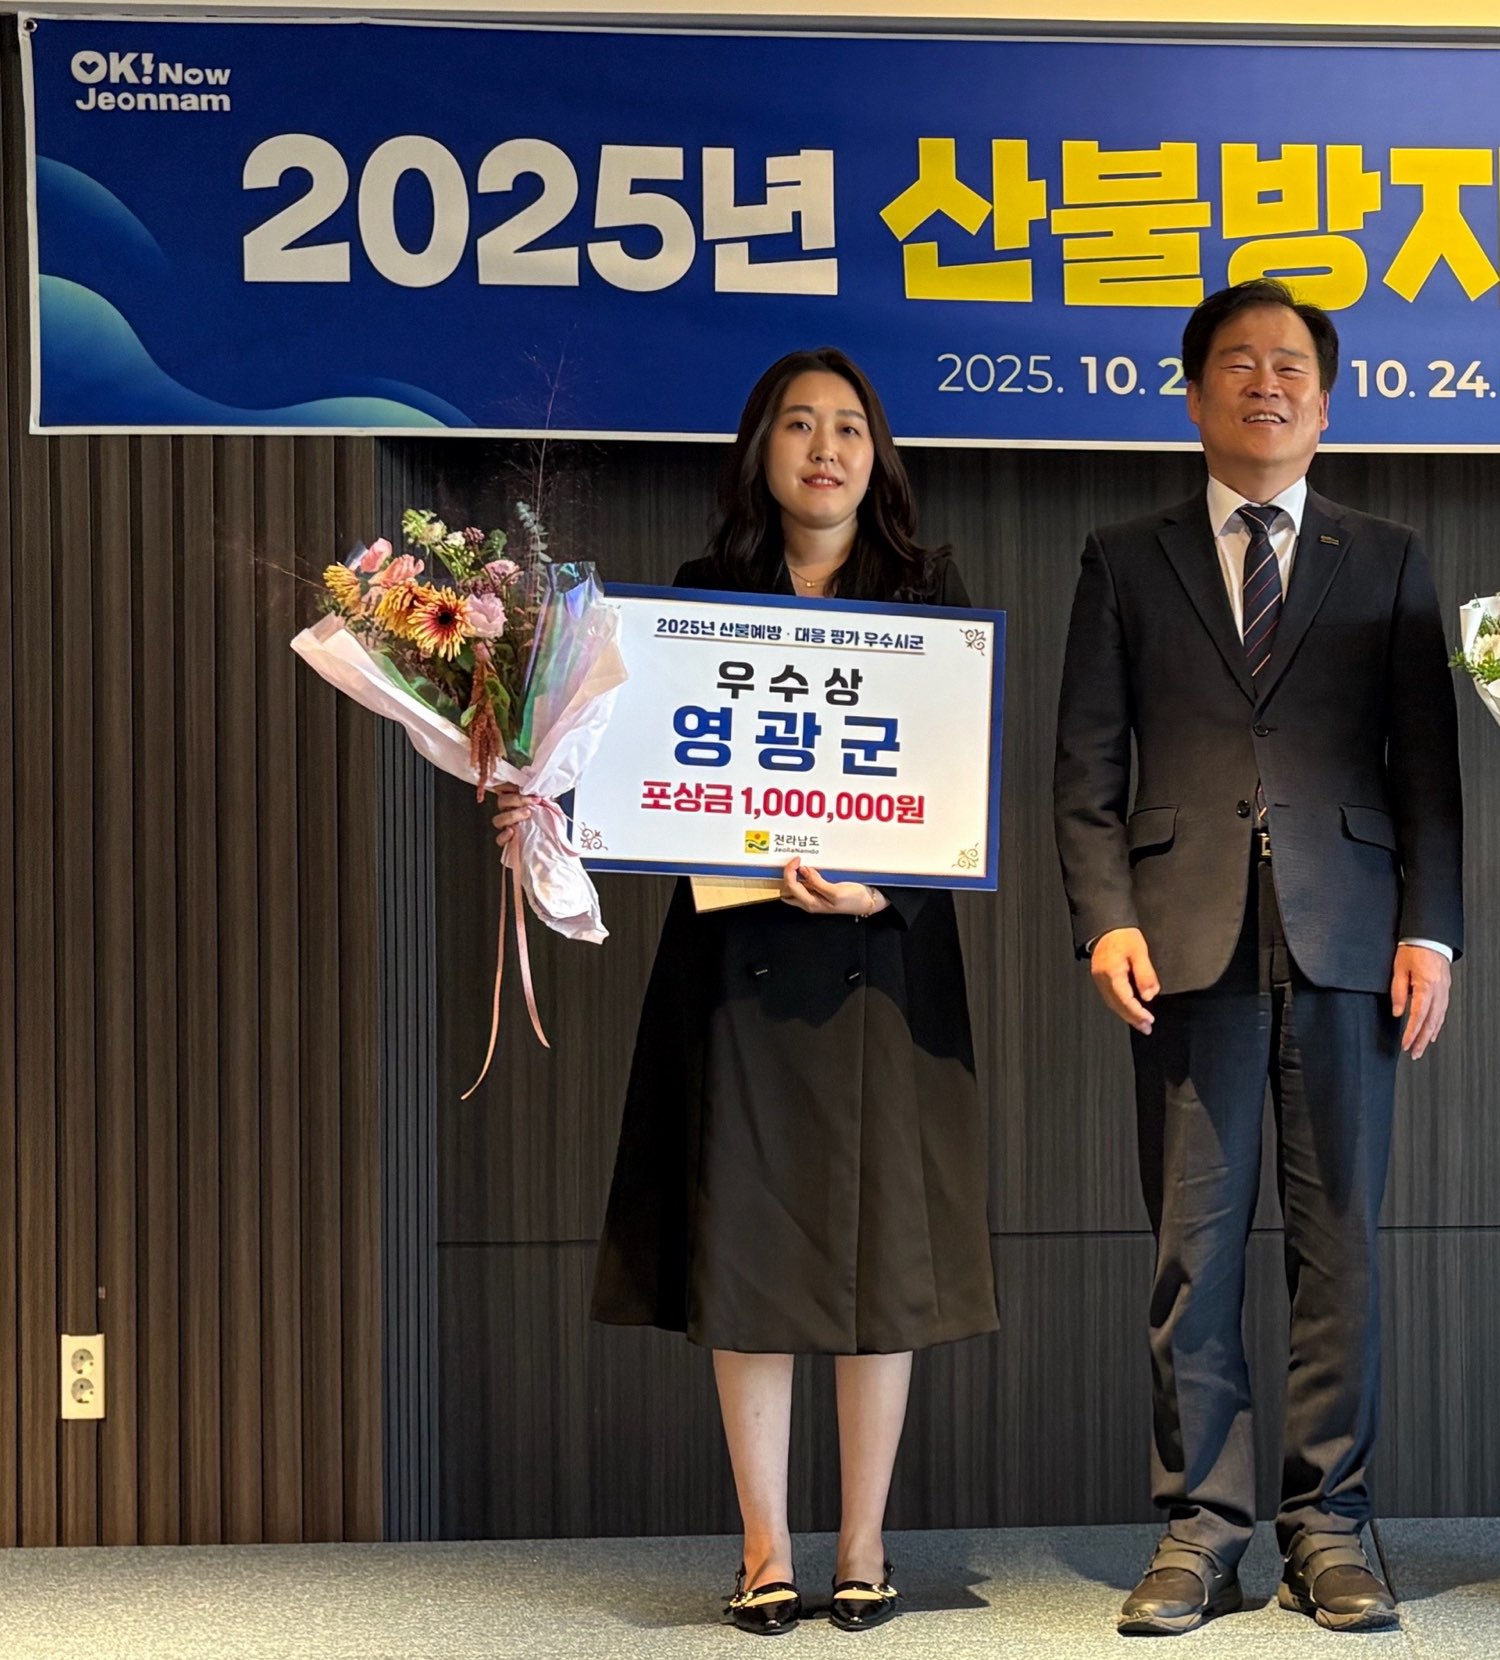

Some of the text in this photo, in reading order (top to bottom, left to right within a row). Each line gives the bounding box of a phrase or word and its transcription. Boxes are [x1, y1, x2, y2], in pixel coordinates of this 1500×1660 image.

[71, 50, 231, 85] OK! Now
[76, 88, 230, 111] Jeonnam
[243, 133, 838, 296] 2025년
[938, 353, 1064, 394] 2025.
[1080, 356, 1146, 395] 10.
[1158, 357, 1188, 396] 2
[1351, 359, 1416, 399] 10.
[656, 618, 716, 636] 2025년
[719, 621, 782, 641] 산불예방
[794, 626, 826, 644] 대응
[830, 629, 860, 647] 평가
[863, 632, 925, 650] 우수시군
[640, 779, 926, 825] 포상금 1,000,000원
[773, 833, 820, 847] 전라남도
